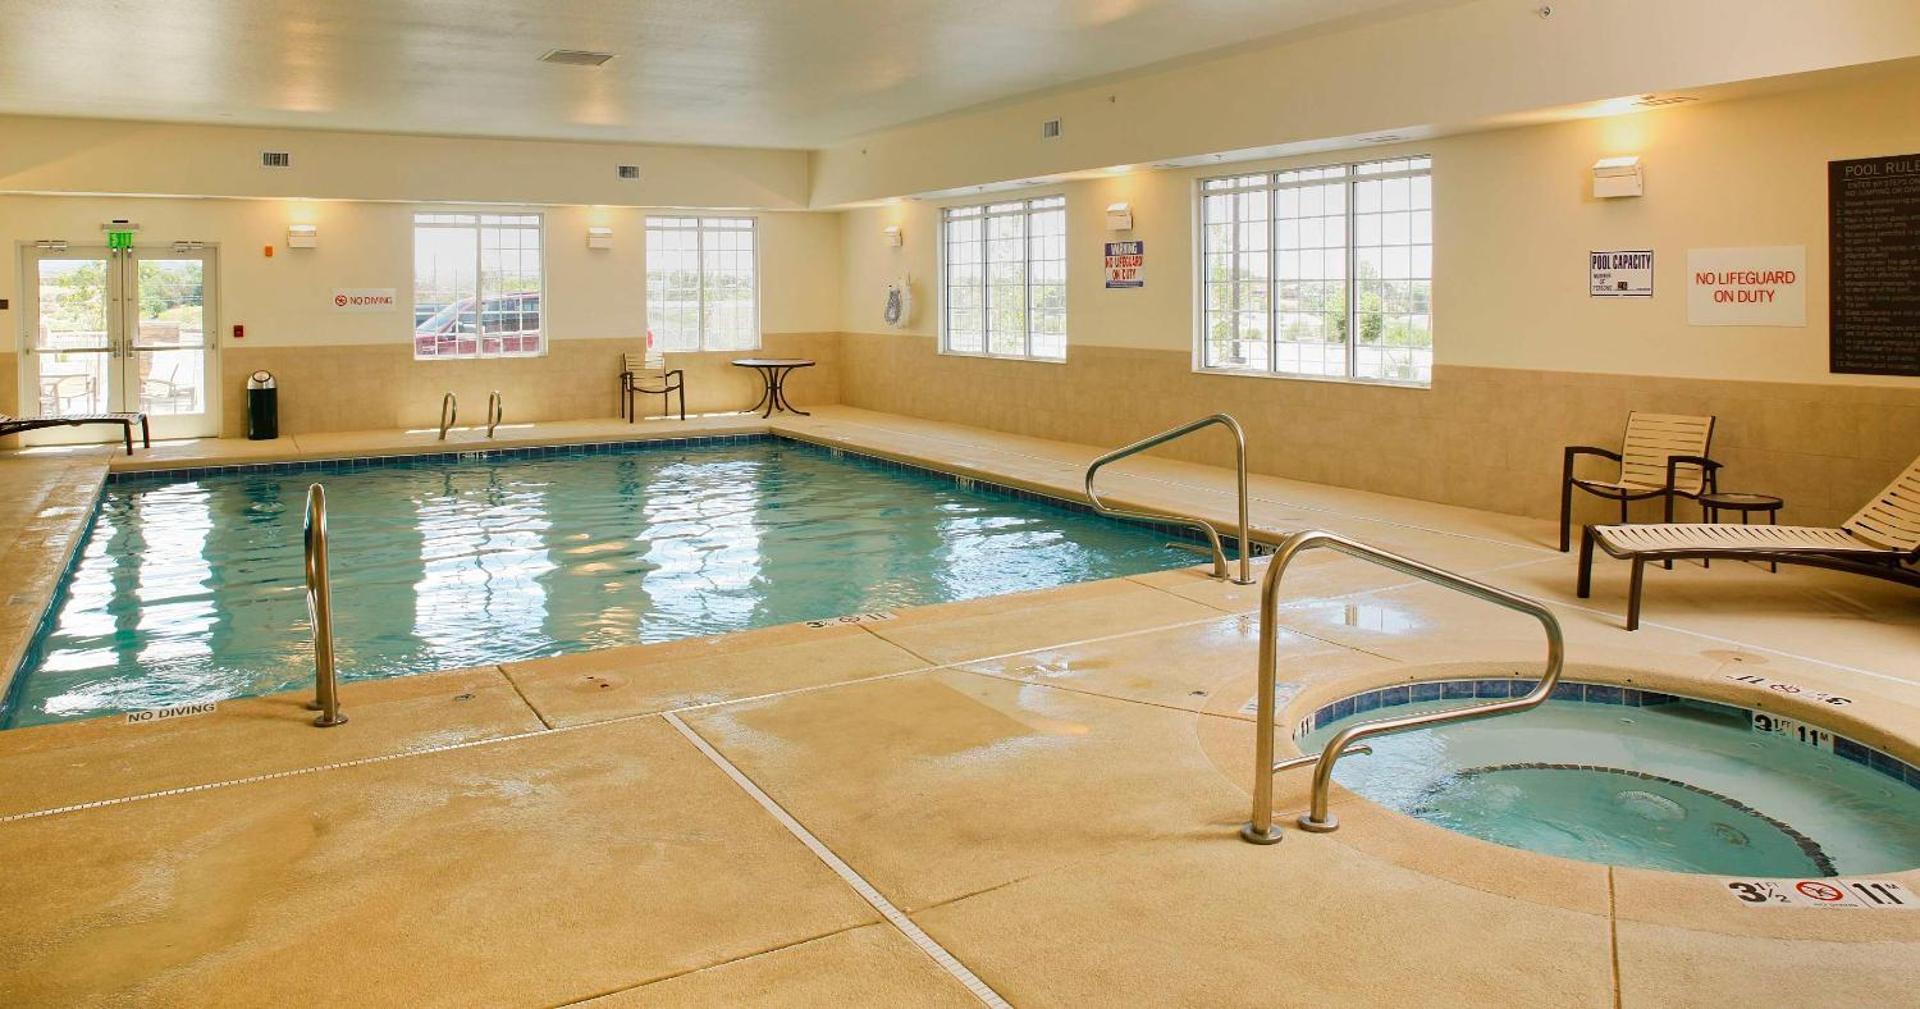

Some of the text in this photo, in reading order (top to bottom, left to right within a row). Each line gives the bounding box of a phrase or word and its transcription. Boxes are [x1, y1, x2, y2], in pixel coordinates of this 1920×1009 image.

[1845, 164, 1880, 177] POOL
[1592, 254, 1651, 270] POOL CAPACITY
[1696, 270, 1796, 285] NO LIFEGUARD
[350, 296, 393, 305] NO DIVING
[1713, 290, 1775, 303] ON DUTY
[128, 703, 215, 722] NO DIVING
